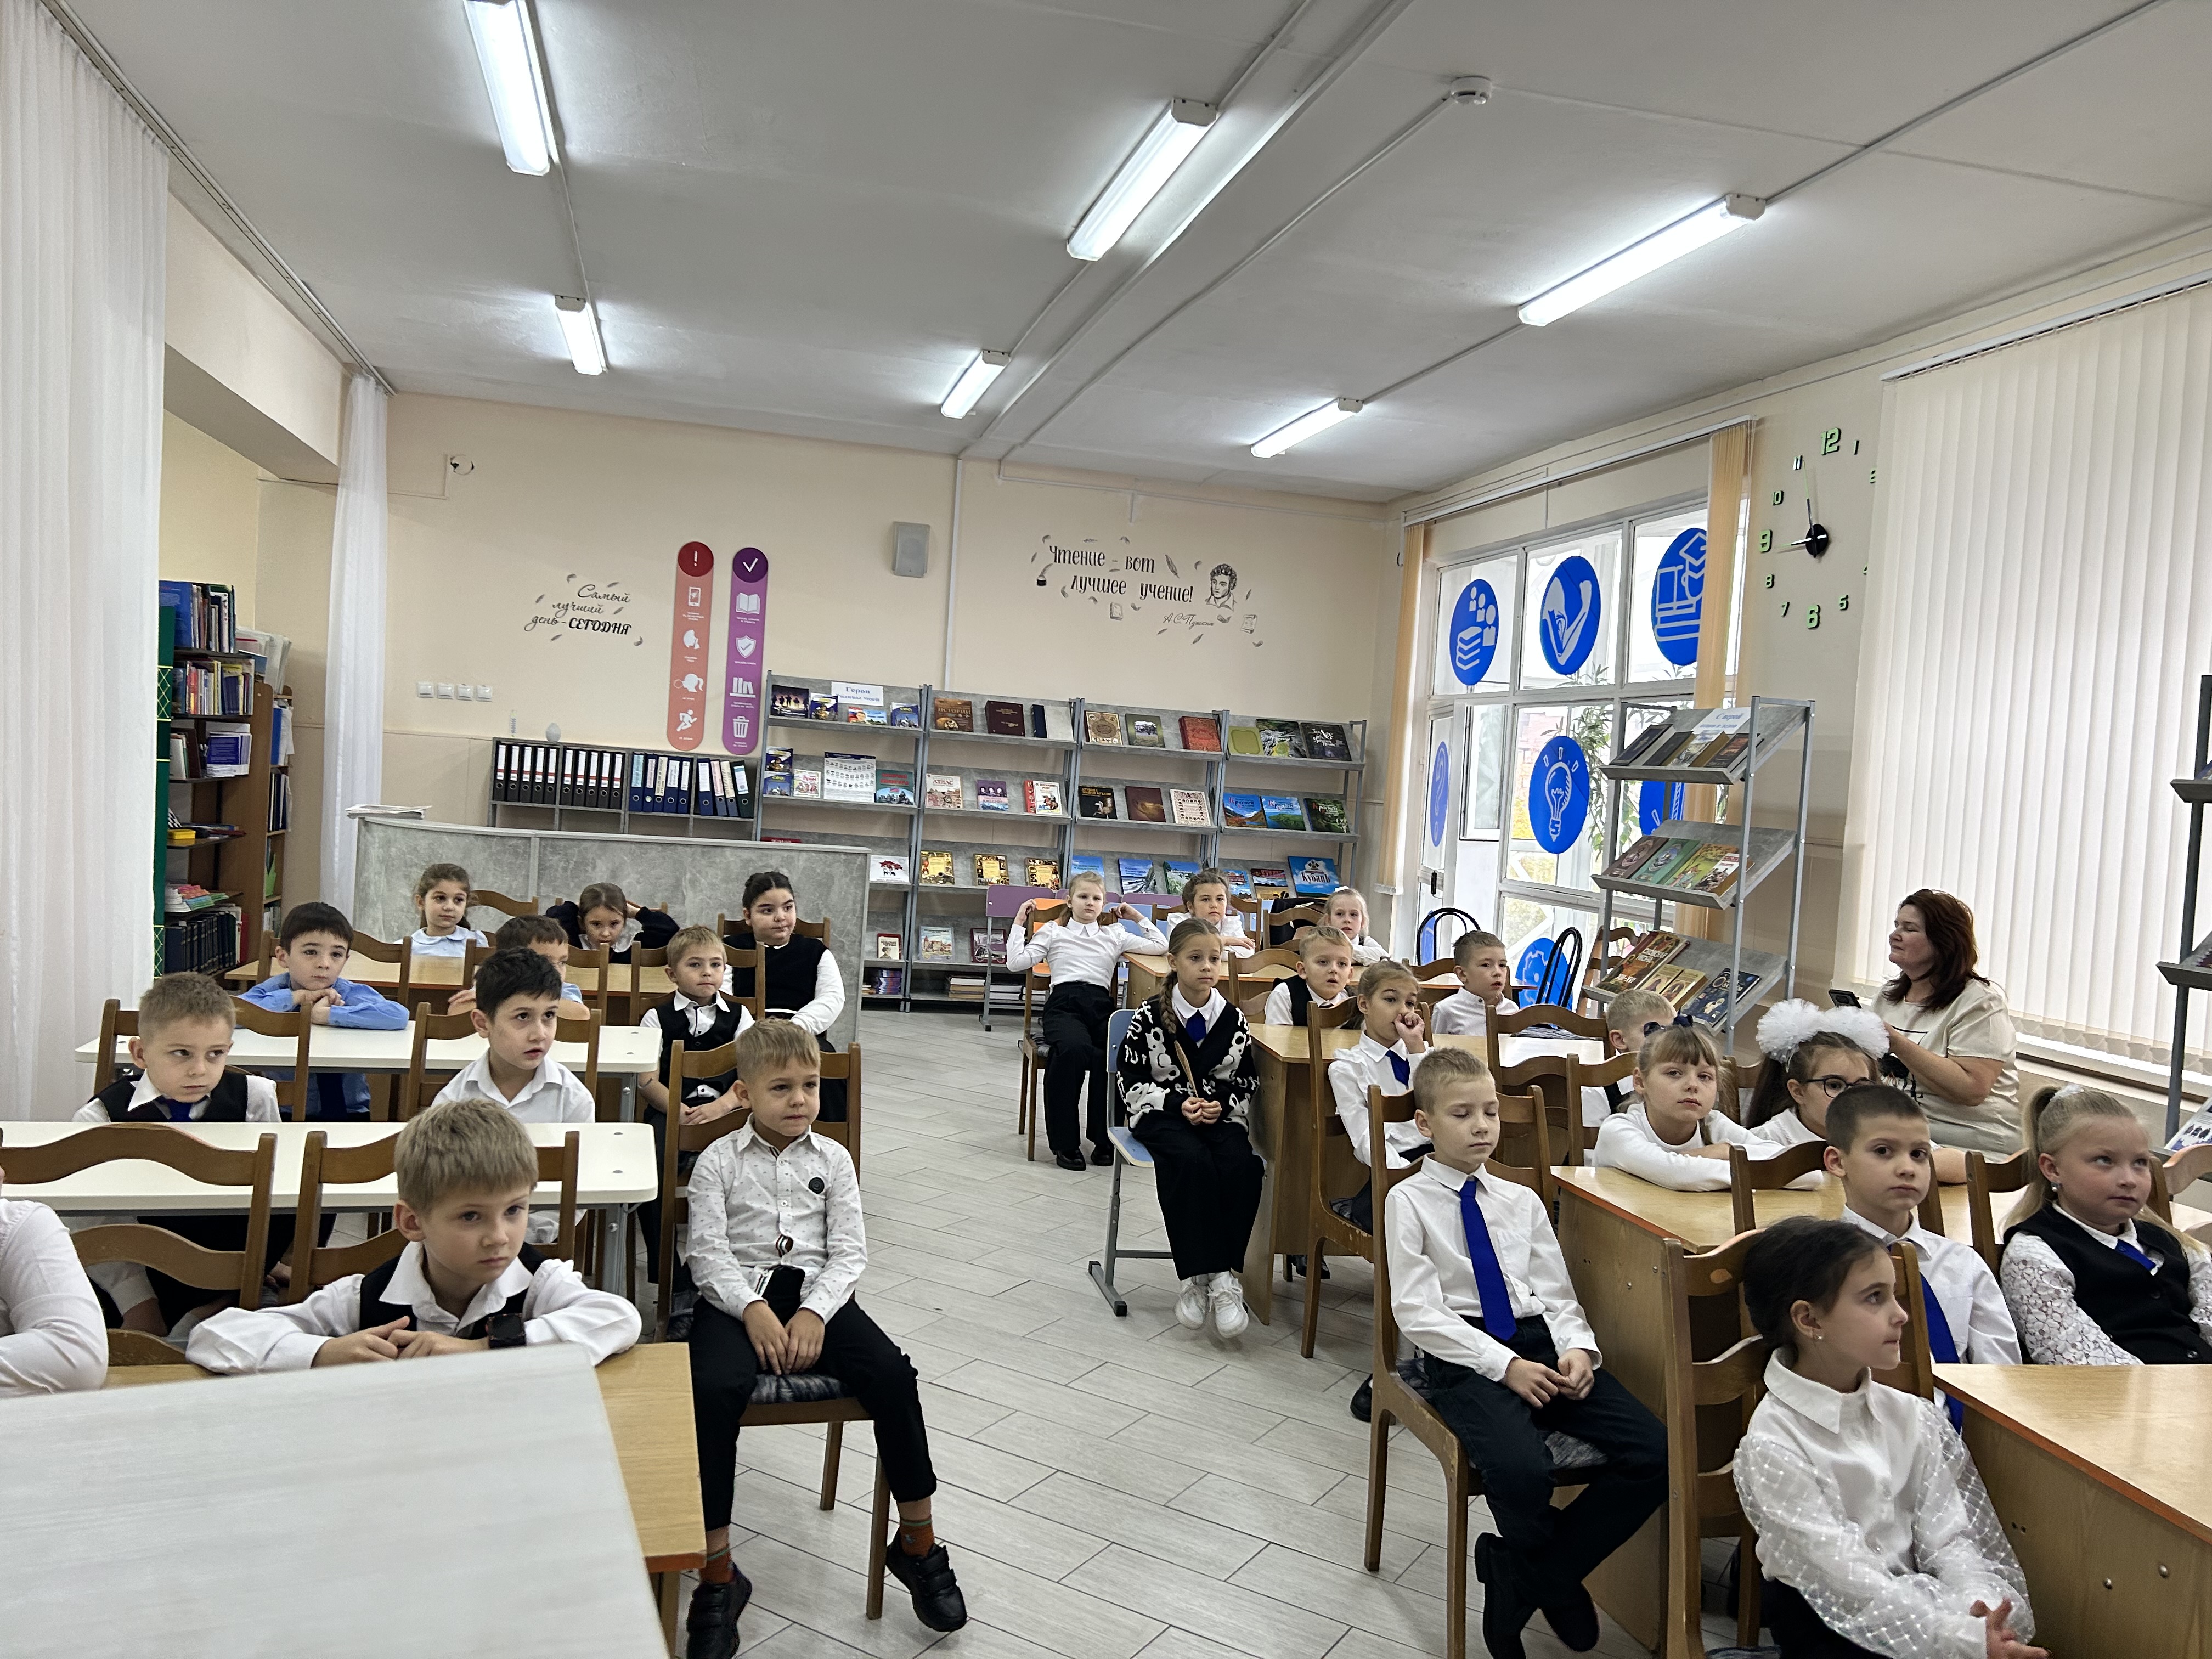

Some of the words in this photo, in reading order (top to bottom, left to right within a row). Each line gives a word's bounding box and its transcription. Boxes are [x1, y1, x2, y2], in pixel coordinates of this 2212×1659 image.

[1821, 428, 1841, 455] 12
[1854, 440, 1859, 455] 1
[1773, 490, 1784, 506] 10
[1759, 529, 1773, 553] 9
[1049, 545, 1105, 566] Чтение
[1125, 556, 1155, 573] вот
[1070, 575, 1126, 594] лучшее
[1140, 583, 1193, 602] учение!
[1765, 574, 1775, 588] 8
[578, 584, 630, 602] Самый
[552, 602, 604, 618] лучший
[1781, 601, 1790, 617] 7
[1839, 595, 1849, 611] 5
[1807, 605, 1820, 628] 6
[524, 616, 559, 631] день
[569, 617, 631, 635] СЕГОДНЯ
[845, 686, 870, 695] Герои
[1301, 872, 1330, 884] Кубань
